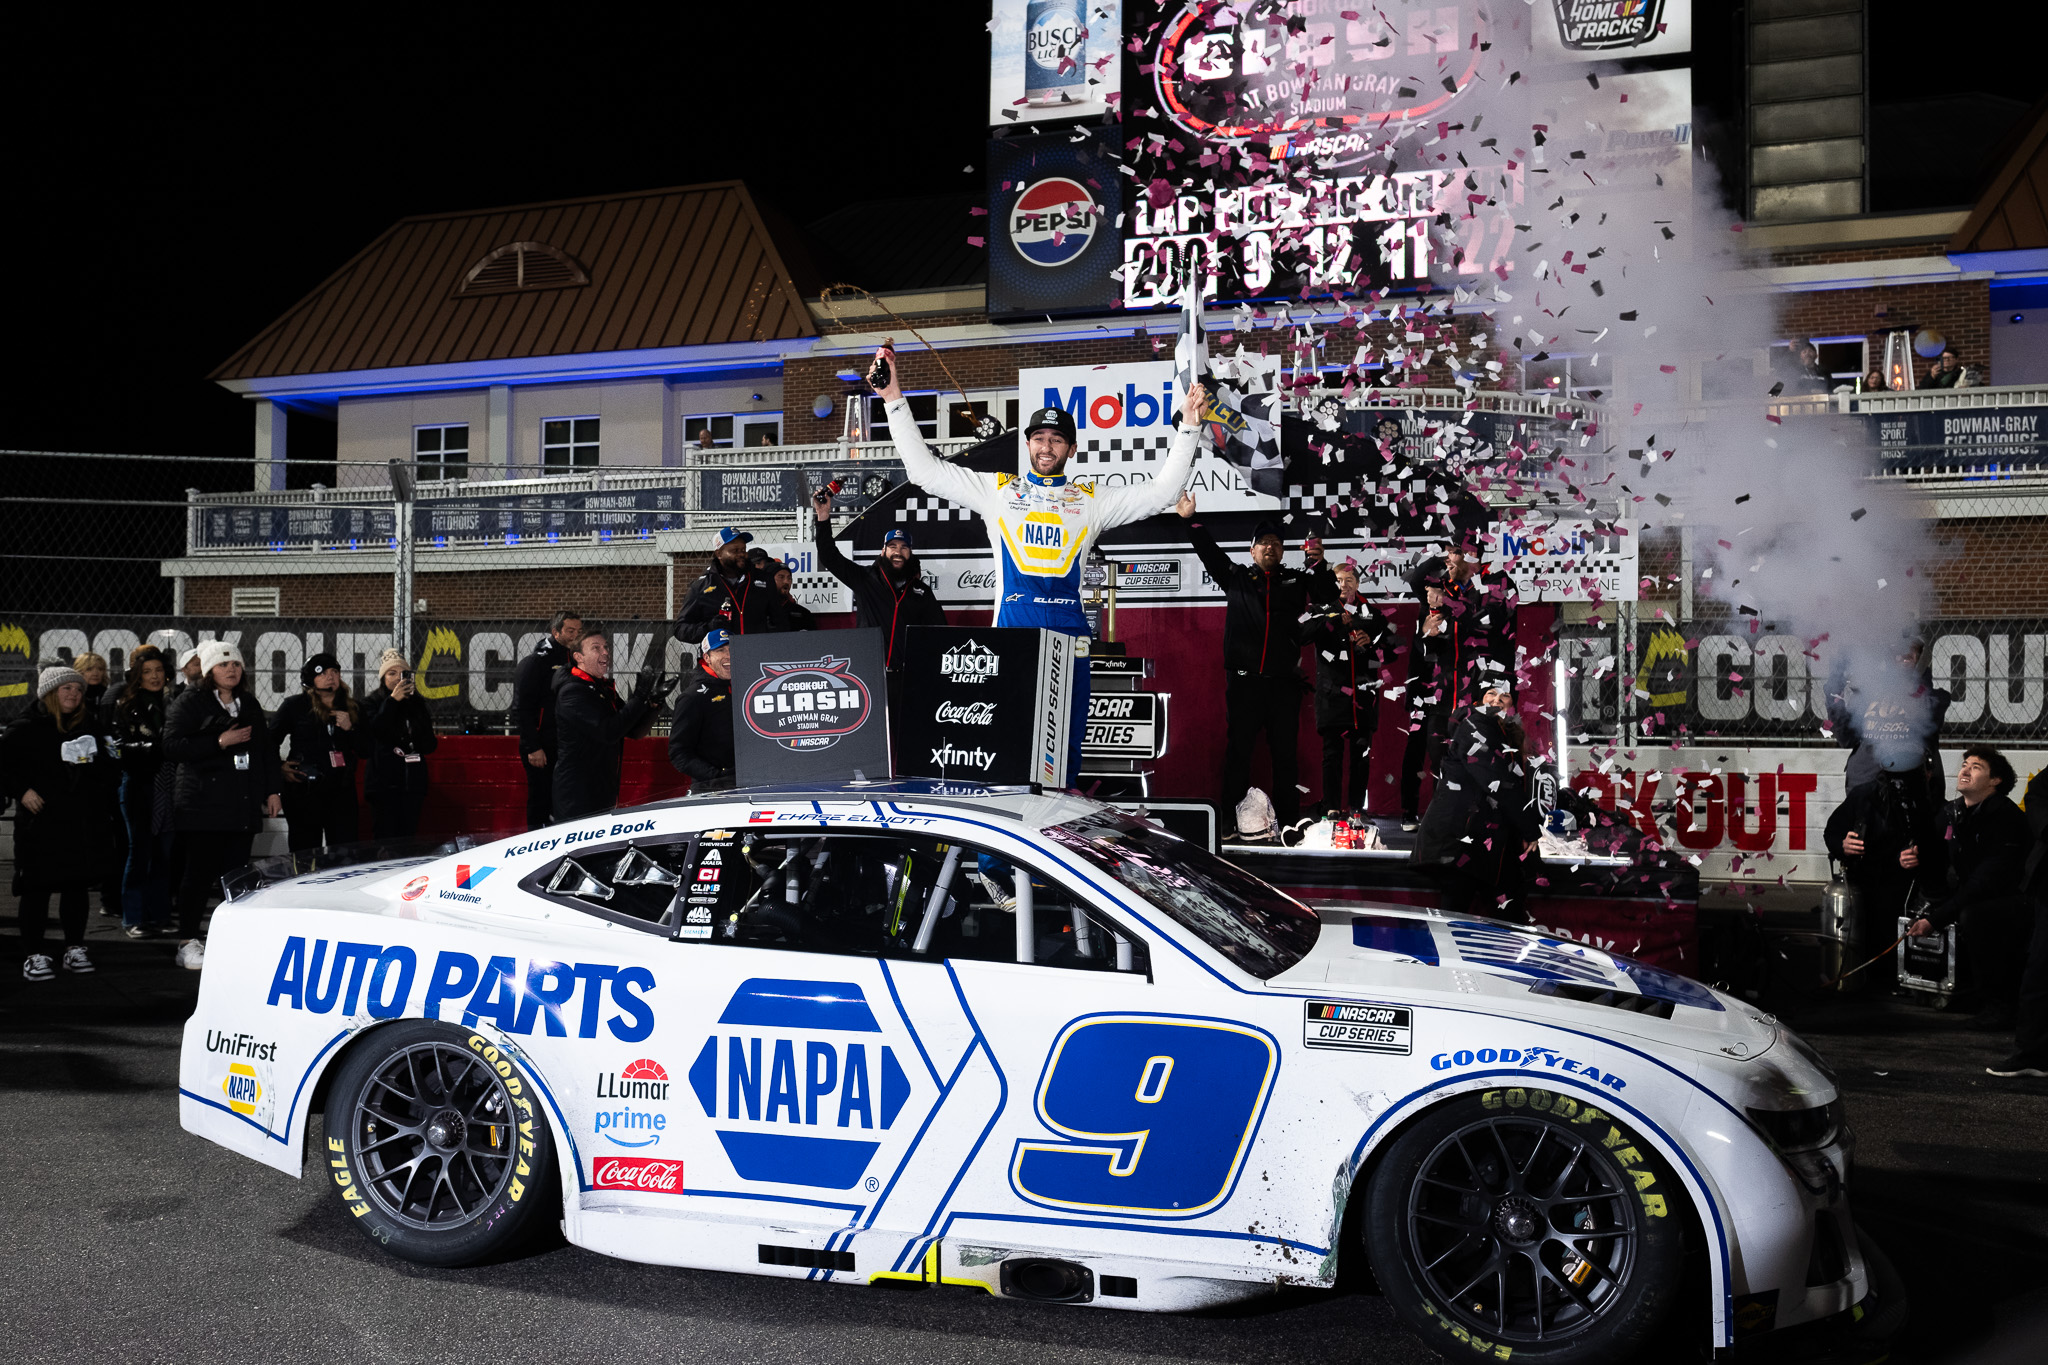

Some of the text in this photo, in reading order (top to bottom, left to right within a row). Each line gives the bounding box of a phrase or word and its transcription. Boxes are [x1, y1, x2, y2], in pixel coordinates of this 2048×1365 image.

[1027, 25, 1084, 51] BUSCH
[1353, 73, 1400, 96] GRAY
[1290, 96, 1347, 117] STADIUM
[1015, 210, 1092, 235] PEPSI
[1243, 231, 1272, 289] 9
[1381, 219, 1429, 280] 11
[1458, 214, 1516, 275] 22
[1043, 383, 1174, 430] Mobi
[1944, 415, 2038, 435] BOWMAN-GRAY
[722, 471, 782, 486] BOWMAN-GRAY
[585, 495, 636, 509] BOWMAN-GRAY
[722, 485, 782, 504] FIELDHOUSE
[288, 509, 333, 521] BOWMAN-GRAY
[431, 515, 480, 531] FIELDHOUSE
[288, 520, 333, 536] FIELDHOUSE
[1025, 523, 1062, 548] NAPA
[1136, 563, 1171, 573] NASCAR
[1358, 558, 1412, 578] xfinit
[1124, 576, 1171, 585] CUP SERIES
[804, 592, 839, 605] LANE
[1033, 597, 1077, 606] ELLIOTT
[940, 653, 1000, 676] BUSCH
[1105, 660, 1127, 669] xfinity
[951, 673, 986, 684] LIGHT
[754, 689, 860, 714] CLASH
[1045, 636, 1062, 754] CUP SERIES
[935, 701, 998, 726] Coca-Cola
[1087, 698, 1134, 718] SCAR
[778, 713, 840, 728] AT BOWMAN GRAY
[797, 722, 820, 730] STADIUM
[799, 737, 830, 747] NASCAR
[1084, 725, 1134, 745] ERIES
[930, 743, 997, 771] xfinity
[777, 813, 937, 826] CHASE ELLIOTT
[1676, 771, 1818, 851] OUT
[503, 819, 658, 859] Kelley Blue Book
[698, 868, 720, 881] CI
[439, 889, 482, 905] Valvoline
[688, 906, 712, 919] MAC
[266, 935, 657, 1043] AUTO PARTS
[1338, 1006, 1396, 1024] NASCAR
[1319, 1025, 1397, 1043] CUP SERIES
[206, 1029, 278, 1062] UniFirst
[1430, 1046, 1627, 1093] GOODYEAR
[228, 1075, 256, 1103] NAPA
[597, 1072, 670, 1101] LLumar
[727, 1037, 872, 1131] NAPA
[467, 1035, 534, 1202] GOODYEAR
[594, 1106, 667, 1134] prime
[1010, 1012, 1281, 1218] 9
[1481, 1087, 1668, 1219] GOODYEAR
[328, 1137, 372, 1218] EAGLE
[596, 1160, 682, 1190] Coca-Cola
